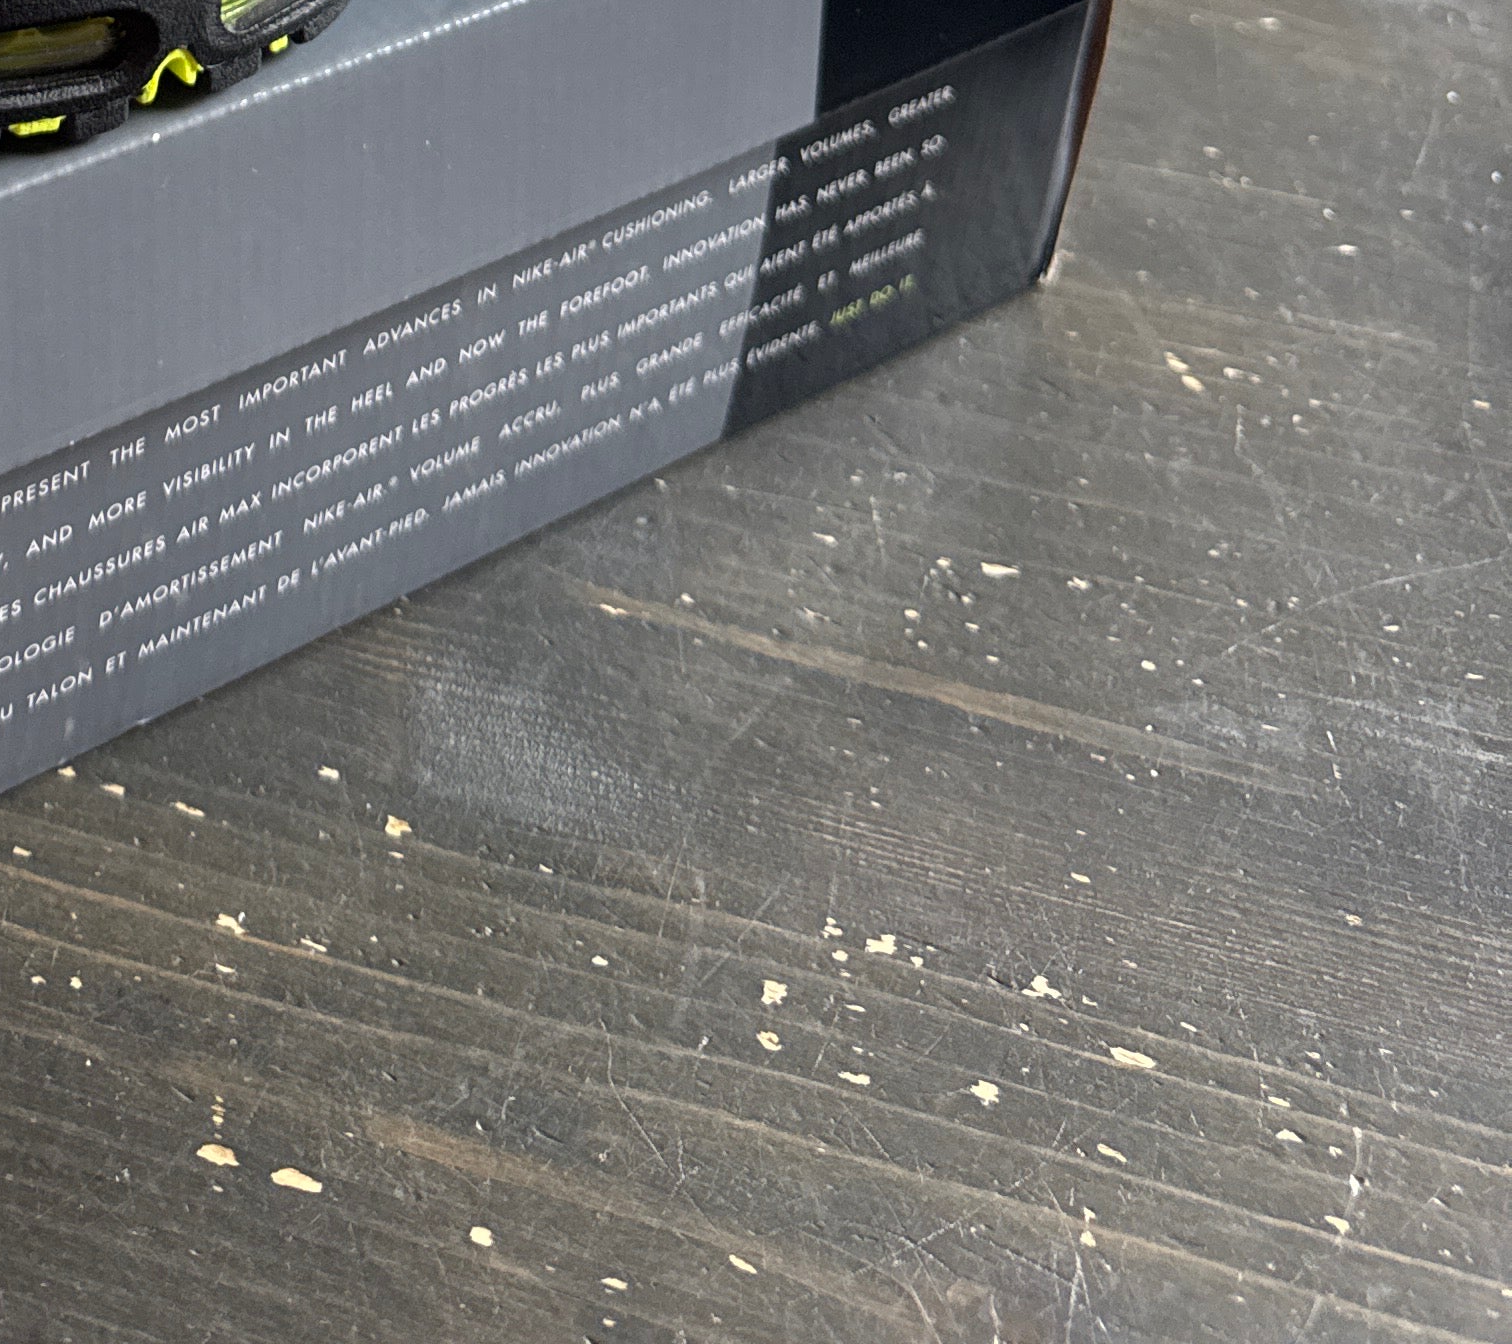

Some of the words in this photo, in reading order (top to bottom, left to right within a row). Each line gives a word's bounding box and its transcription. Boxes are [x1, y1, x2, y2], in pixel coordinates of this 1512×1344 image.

[26, 521, 73, 557] AND
[88, 489, 147, 530] MORE
[162, 441, 254, 497] VISIBILITY
[268, 425, 290, 450] IN
[304, 405, 337, 434] THE
[351, 379, 393, 413] HEEL
[406, 355, 446, 388] AND
[459, 328, 506, 363] NOW
[516, 309, 548, 337] THE
[662, 211, 766, 271] INNOVATION
[774, 192, 808, 220] HAS
[816, 166, 867, 202] NEVER
[873, 146, 911, 176] BEEN
[919, 133, 941, 155] SO
[34, 534, 165, 606] CHAUSSURES
[176, 514, 209, 543] AIR
[219, 489, 262, 523] MAX
[271, 424, 402, 499] INCORPORENT
[412, 407, 439, 434] LES
[449, 366, 528, 417] PROGRÈS
[535, 350, 563, 378] LES
[570, 329, 609, 361] PLUS
[617, 279, 718, 339] IMPORTANTS
[722, 263, 753, 290] QUI
[759, 239, 805, 273] AIENT
[811, 221, 838, 249] ÉTÉ
[98, 529, 282, 628] D'AMORTISSEMENT
[408, 435, 480, 483] VOLUME
[579, 370, 618, 402] PLUS
[635, 330, 703, 375] GRANDE
[816, 268, 835, 289] ET
[109, 436, 145, 466] THE
[164, 404, 220, 442] MOST
[238, 348, 347, 410] IMPORTANT
[362, 297, 462, 356] ADVANCES
[476, 282, 496, 306] IN
[727, 154, 787, 195] LARGER
[886, 82, 953, 125] GREATER
[26, 665, 92, 709] TALON
[105, 649, 126, 673] ET
[138, 584, 265, 658] MAINTENANT
[277, 568, 300, 592] DE
[441, 468, 505, 512] JAMAIS
[514, 414, 621, 477] INNOVATION
[628, 396, 659, 423] N'A
[667, 376, 694, 404] ÉTÉ
[701, 356, 739, 387] PLUS
